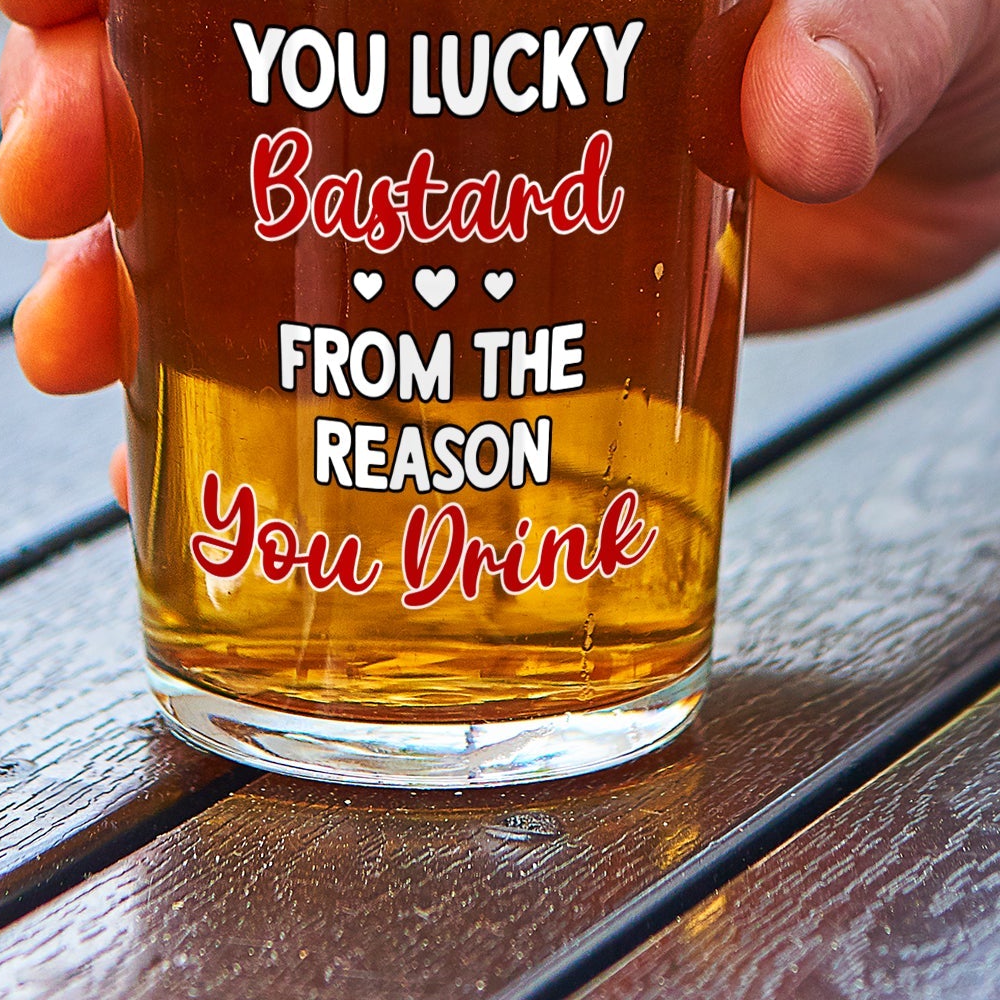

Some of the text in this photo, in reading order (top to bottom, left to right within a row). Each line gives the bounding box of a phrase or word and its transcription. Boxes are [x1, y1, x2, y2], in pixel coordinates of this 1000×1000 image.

[232, 18, 646, 118] YOU LUCKY
[249, 127, 625, 253] Bastard
[277, 320, 587, 402] FROM THE
[314, 416, 553, 493] REASON
[190, 470, 658, 609] You Drink
